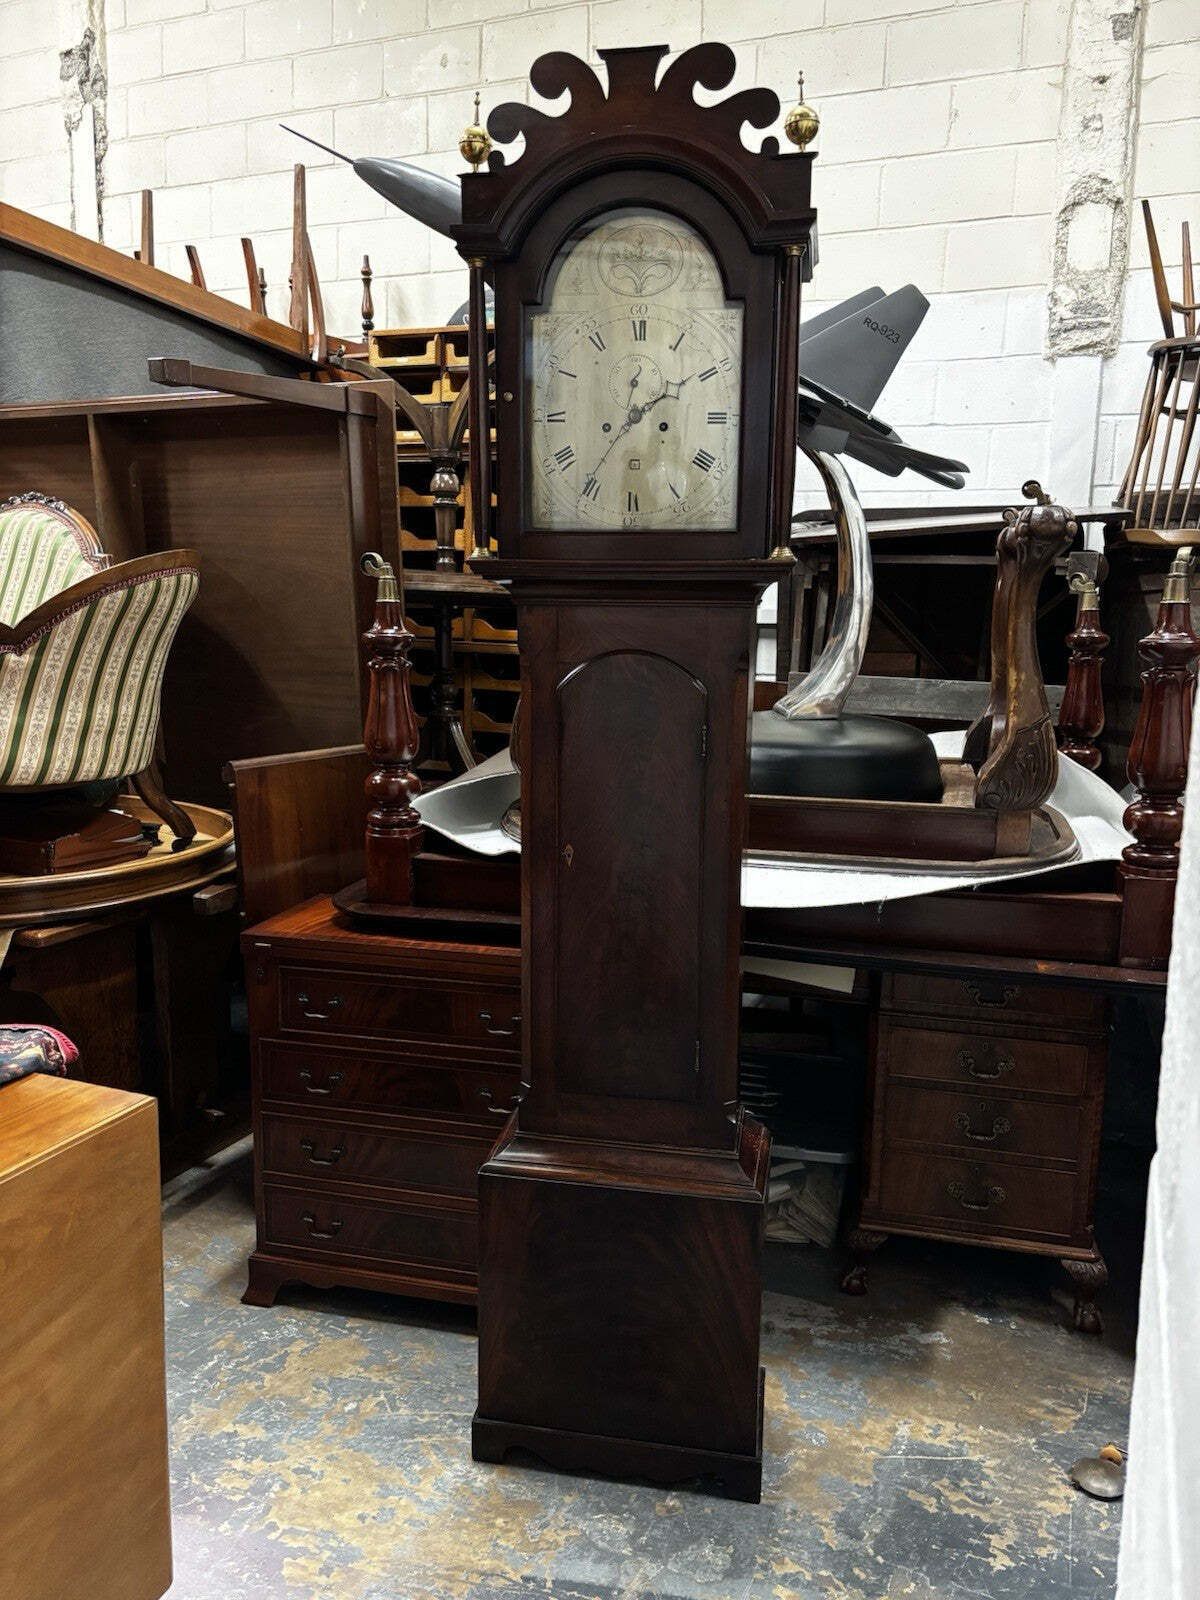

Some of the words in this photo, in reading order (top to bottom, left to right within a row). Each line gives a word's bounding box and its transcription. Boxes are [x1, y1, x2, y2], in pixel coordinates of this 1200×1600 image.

[863, 317, 900, 344] RQ-923
[698, 366, 719, 383] II
[707, 412, 728, 425] III
[692, 448, 716, 473] IIII
